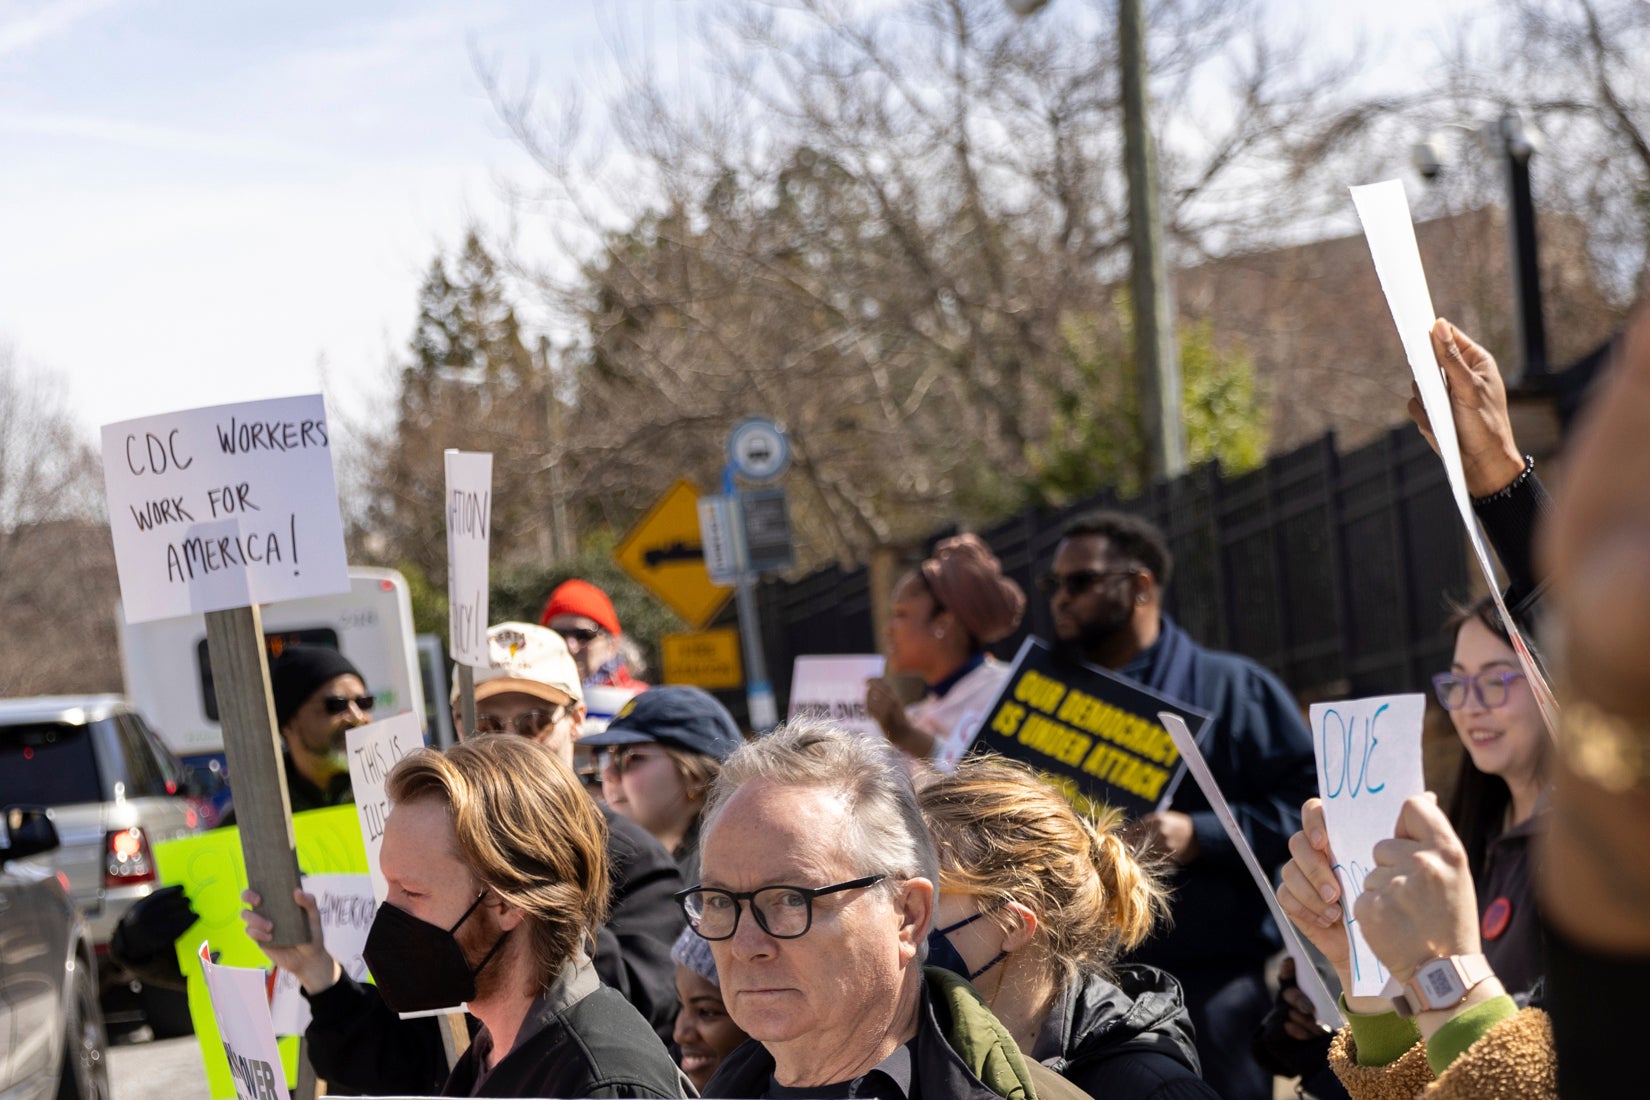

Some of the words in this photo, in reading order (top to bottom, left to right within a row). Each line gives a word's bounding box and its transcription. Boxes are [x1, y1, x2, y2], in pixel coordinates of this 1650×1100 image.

[126, 429, 193, 476] CDC
[217, 417, 329, 455] WORKERS
[130, 495, 194, 532] WORK
[207, 483, 261, 518] FOR
[166, 513, 301, 583] AMERICA!
[1014, 669, 1067, 714] OUR
[991, 700, 1026, 737] IS
[1016, 711, 1093, 768] UNDER
[1082, 741, 1170, 802] ATTACK
[1323, 703, 1389, 799] DUE
